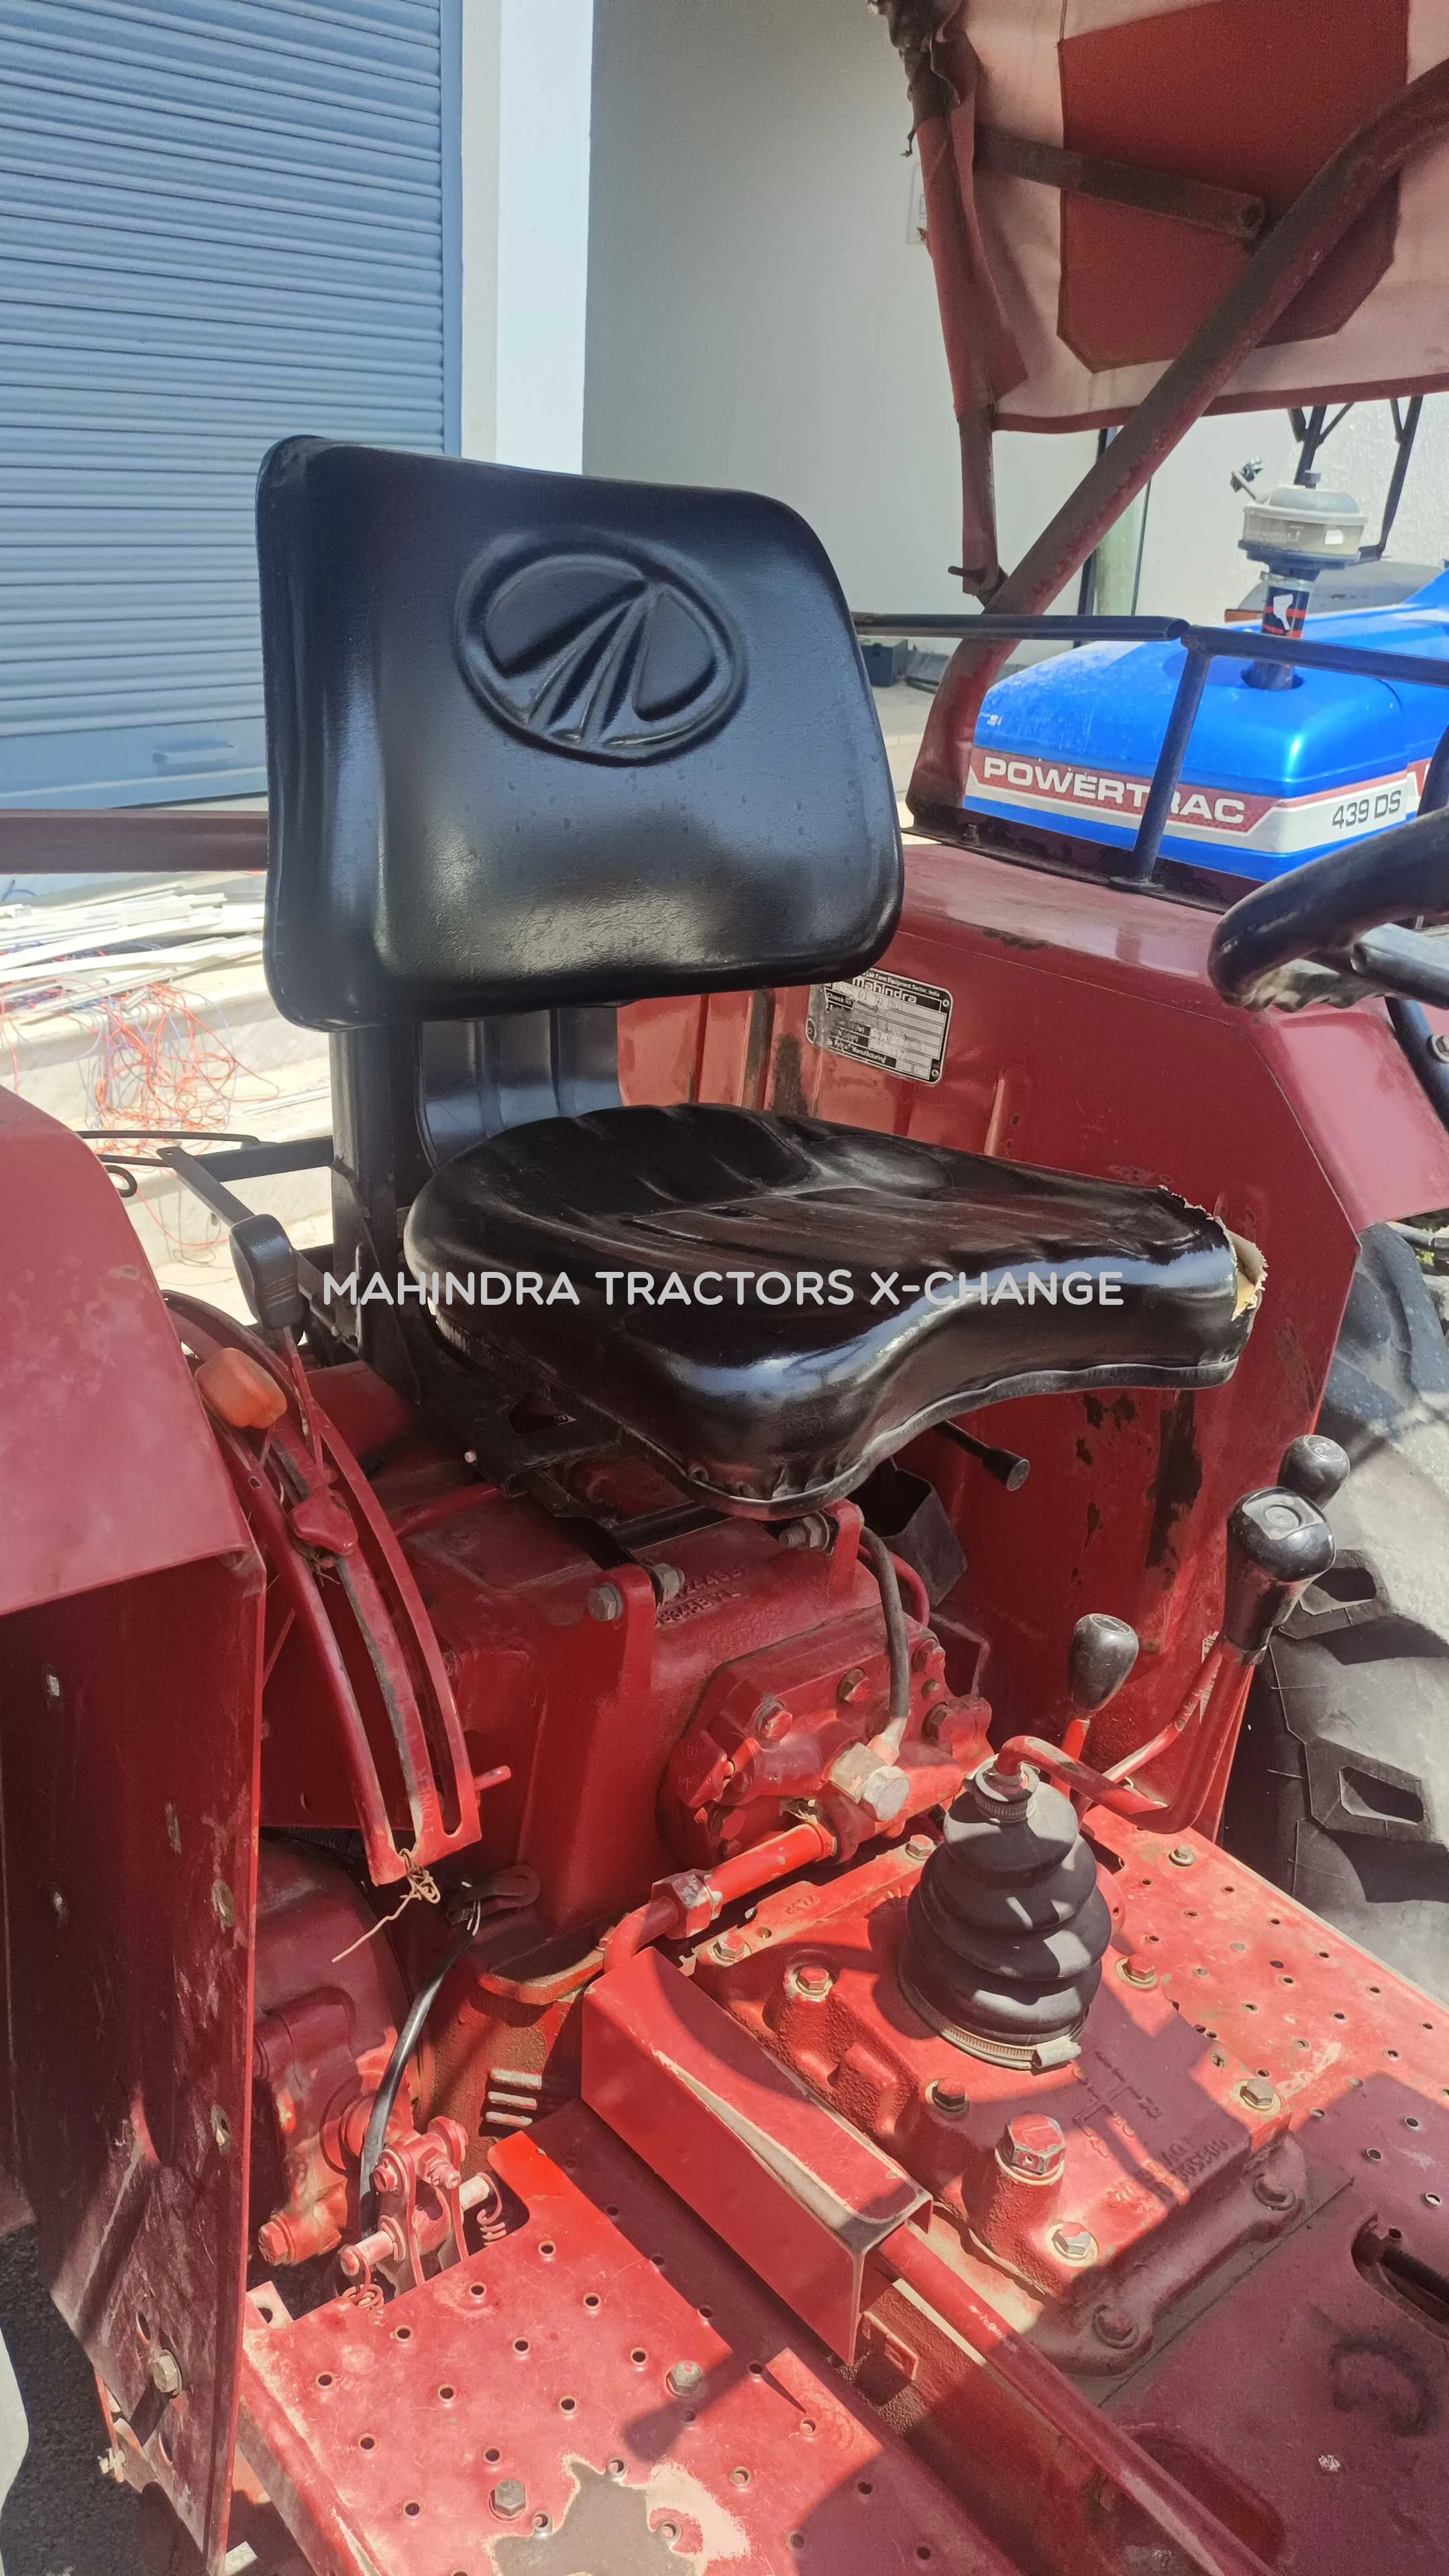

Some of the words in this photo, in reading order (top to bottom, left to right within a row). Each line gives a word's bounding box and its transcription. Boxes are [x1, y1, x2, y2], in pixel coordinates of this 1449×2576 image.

[1332, 799, 1370, 829] 439
[1374, 790, 1402, 819] DS
[852, 977, 918, 1004] mahindra
